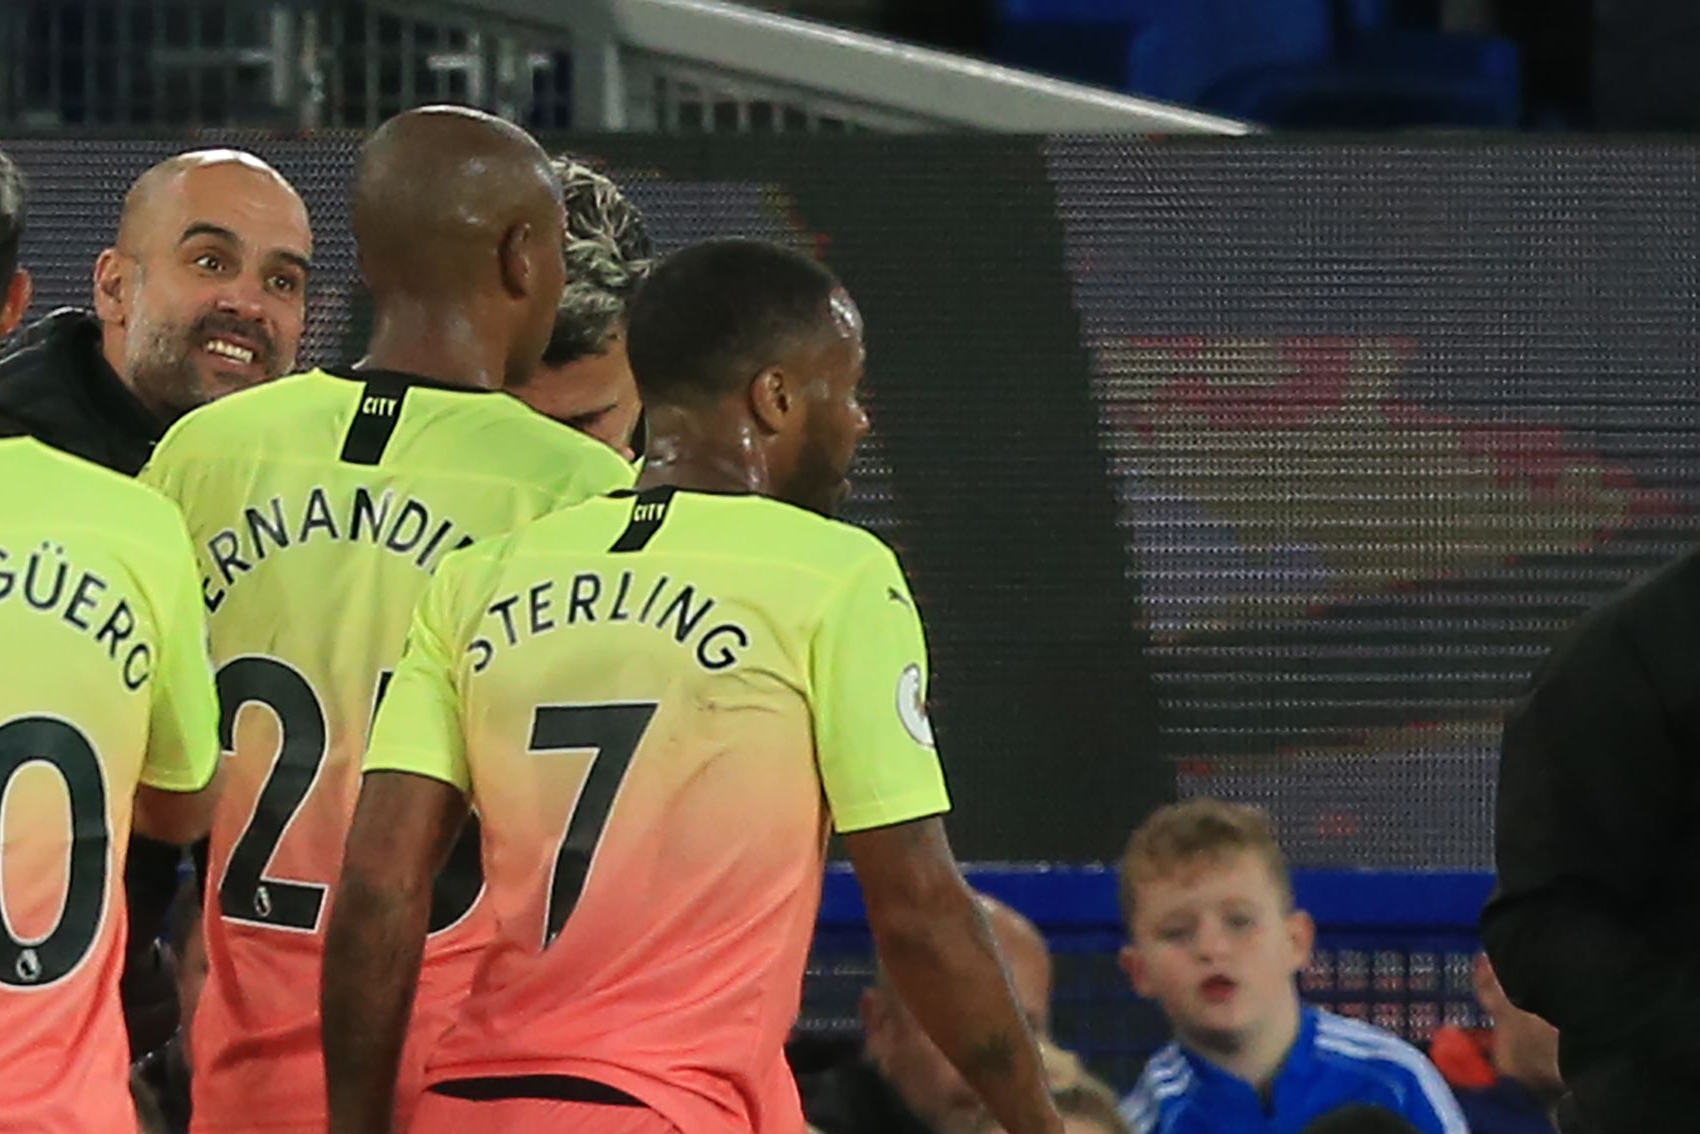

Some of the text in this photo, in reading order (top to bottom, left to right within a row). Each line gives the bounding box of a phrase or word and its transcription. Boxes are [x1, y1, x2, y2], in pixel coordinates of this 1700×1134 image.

[362, 397, 398, 416] CITY
[201, 488, 475, 614] ERNANDI
[633, 503, 666, 521] CITY
[467, 570, 749, 673] STERLING
[215, 655, 487, 939] 2
[526, 700, 661, 952] 7
